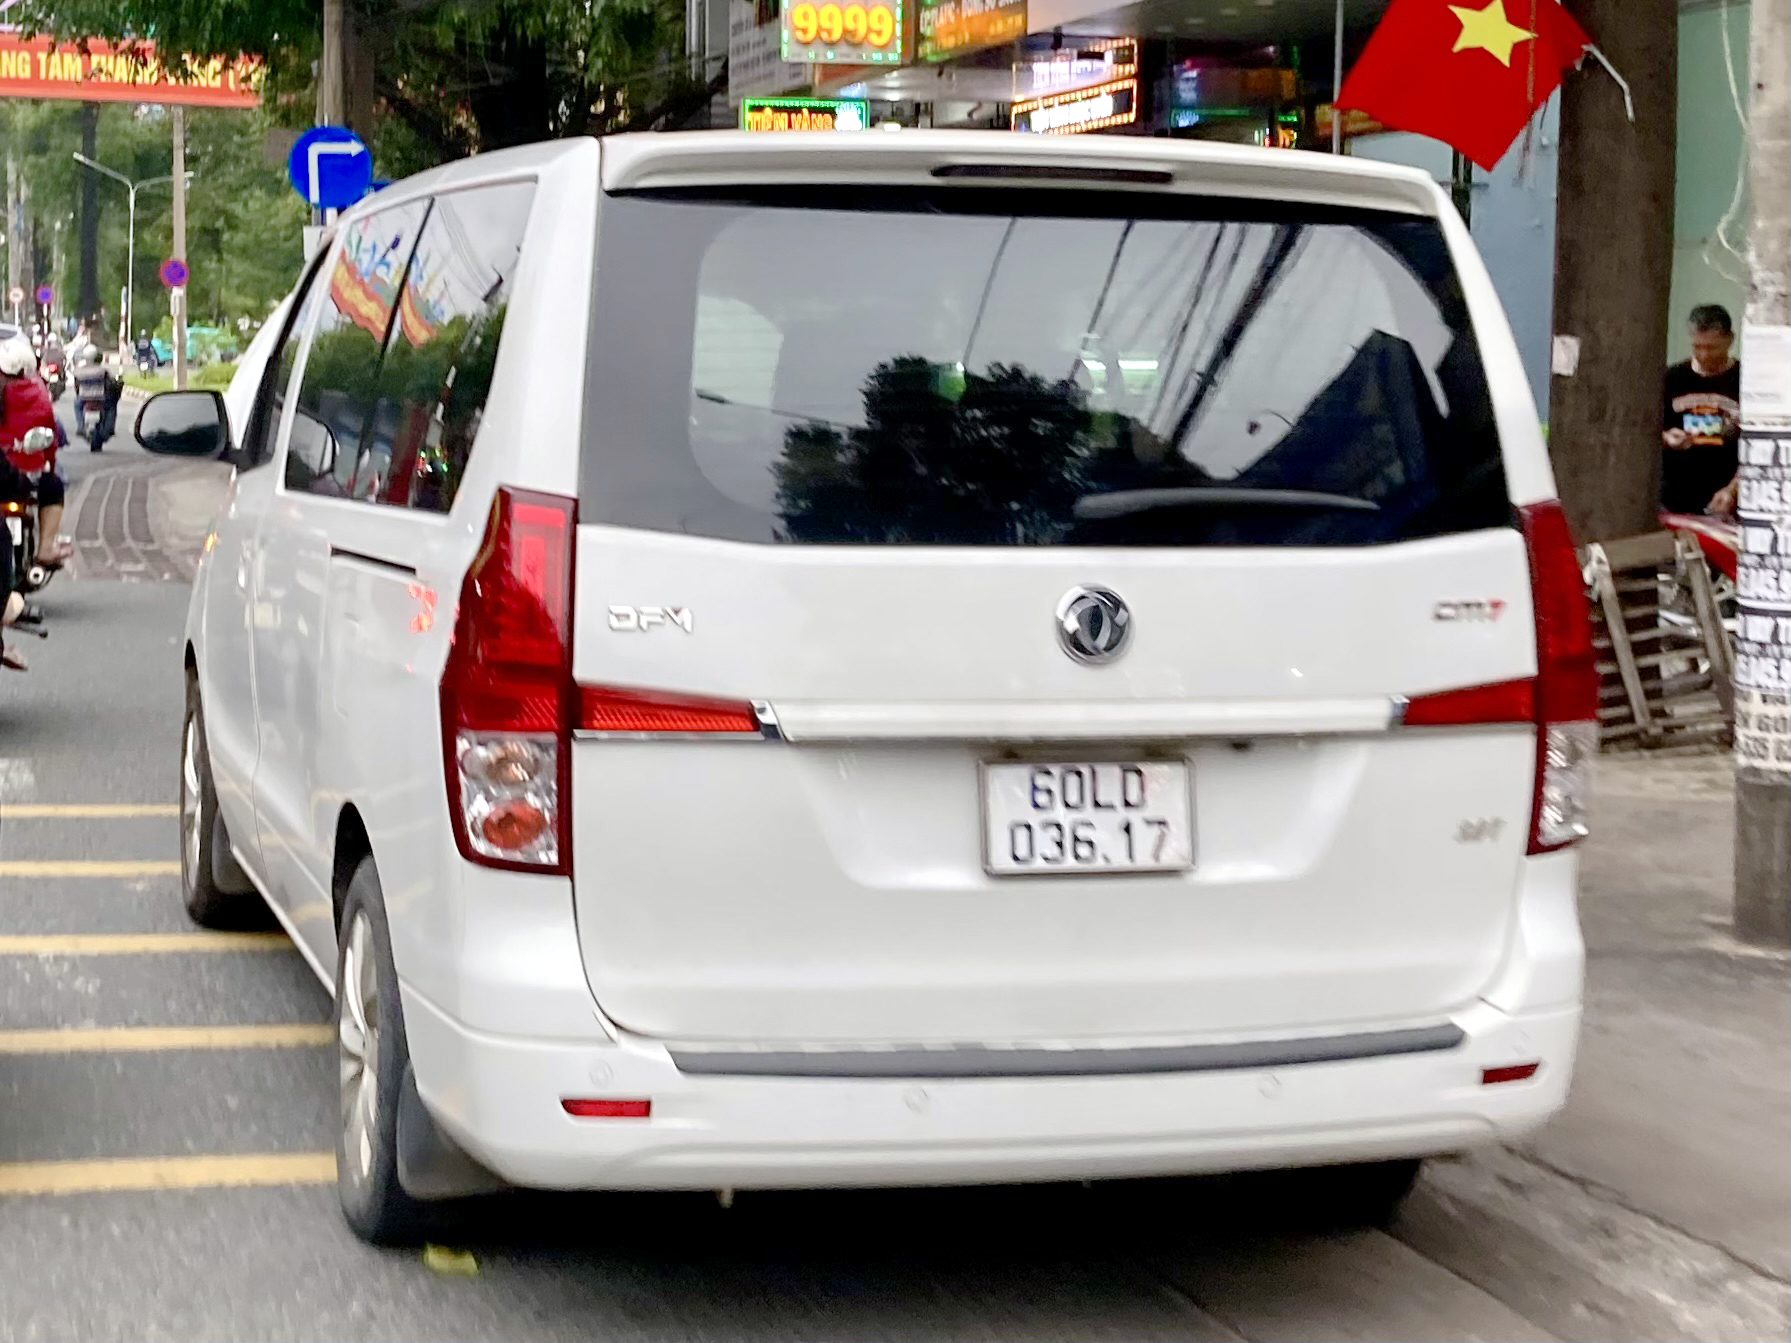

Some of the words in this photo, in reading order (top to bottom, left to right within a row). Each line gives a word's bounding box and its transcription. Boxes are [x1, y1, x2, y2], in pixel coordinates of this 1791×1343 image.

[792, 3, 894, 47] 9999
[608, 604, 694, 634] DFM
[1031, 764, 1147, 810] 60LD
[1009, 818, 1170, 864] 036.17
